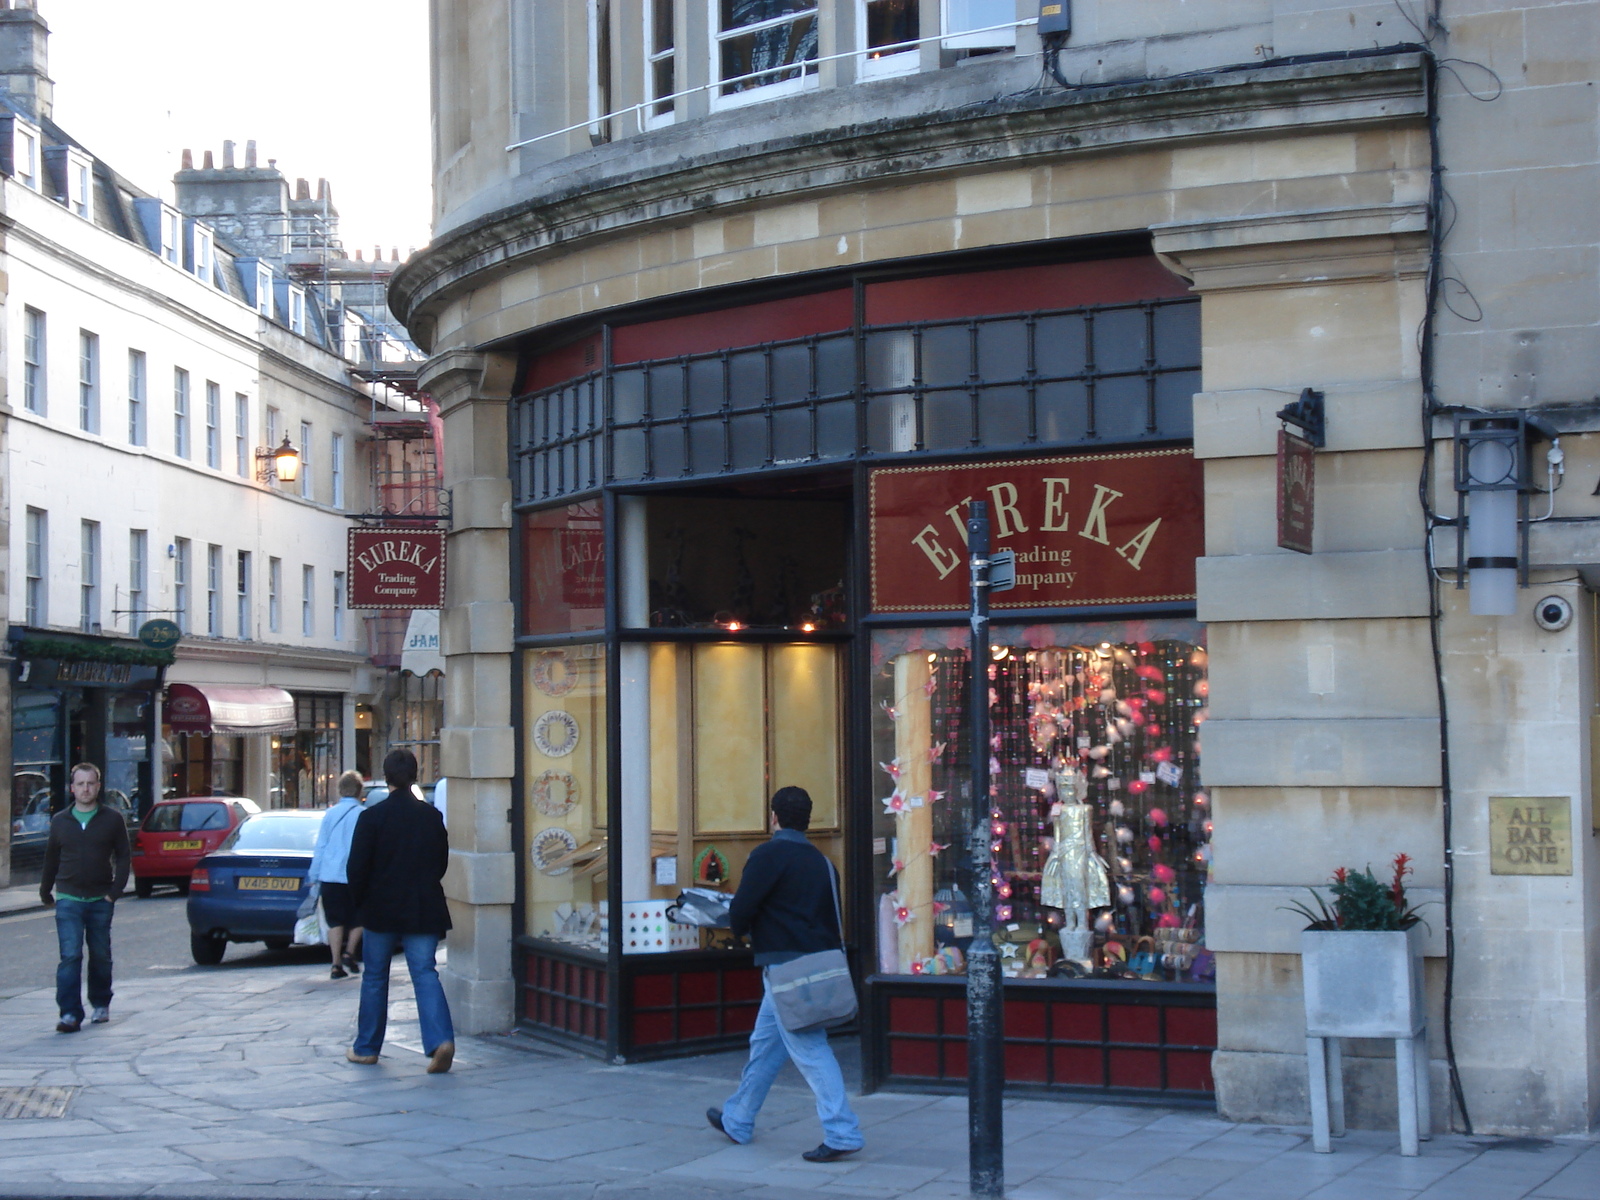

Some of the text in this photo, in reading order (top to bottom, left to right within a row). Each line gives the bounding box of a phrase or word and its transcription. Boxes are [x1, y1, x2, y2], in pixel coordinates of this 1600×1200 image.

[356, 540, 438, 574] EUREKA
[378, 572, 416, 585] Trading
[1015, 571, 1077, 591] mpany
[374, 584, 419, 598] Company
[409, 634, 439, 648] JAM
[1508, 806, 1551, 825] ALL
[1507, 827, 1556, 845] BAR
[1505, 846, 1559, 865] ONE
[243, 878, 295, 889] V415 DVU
